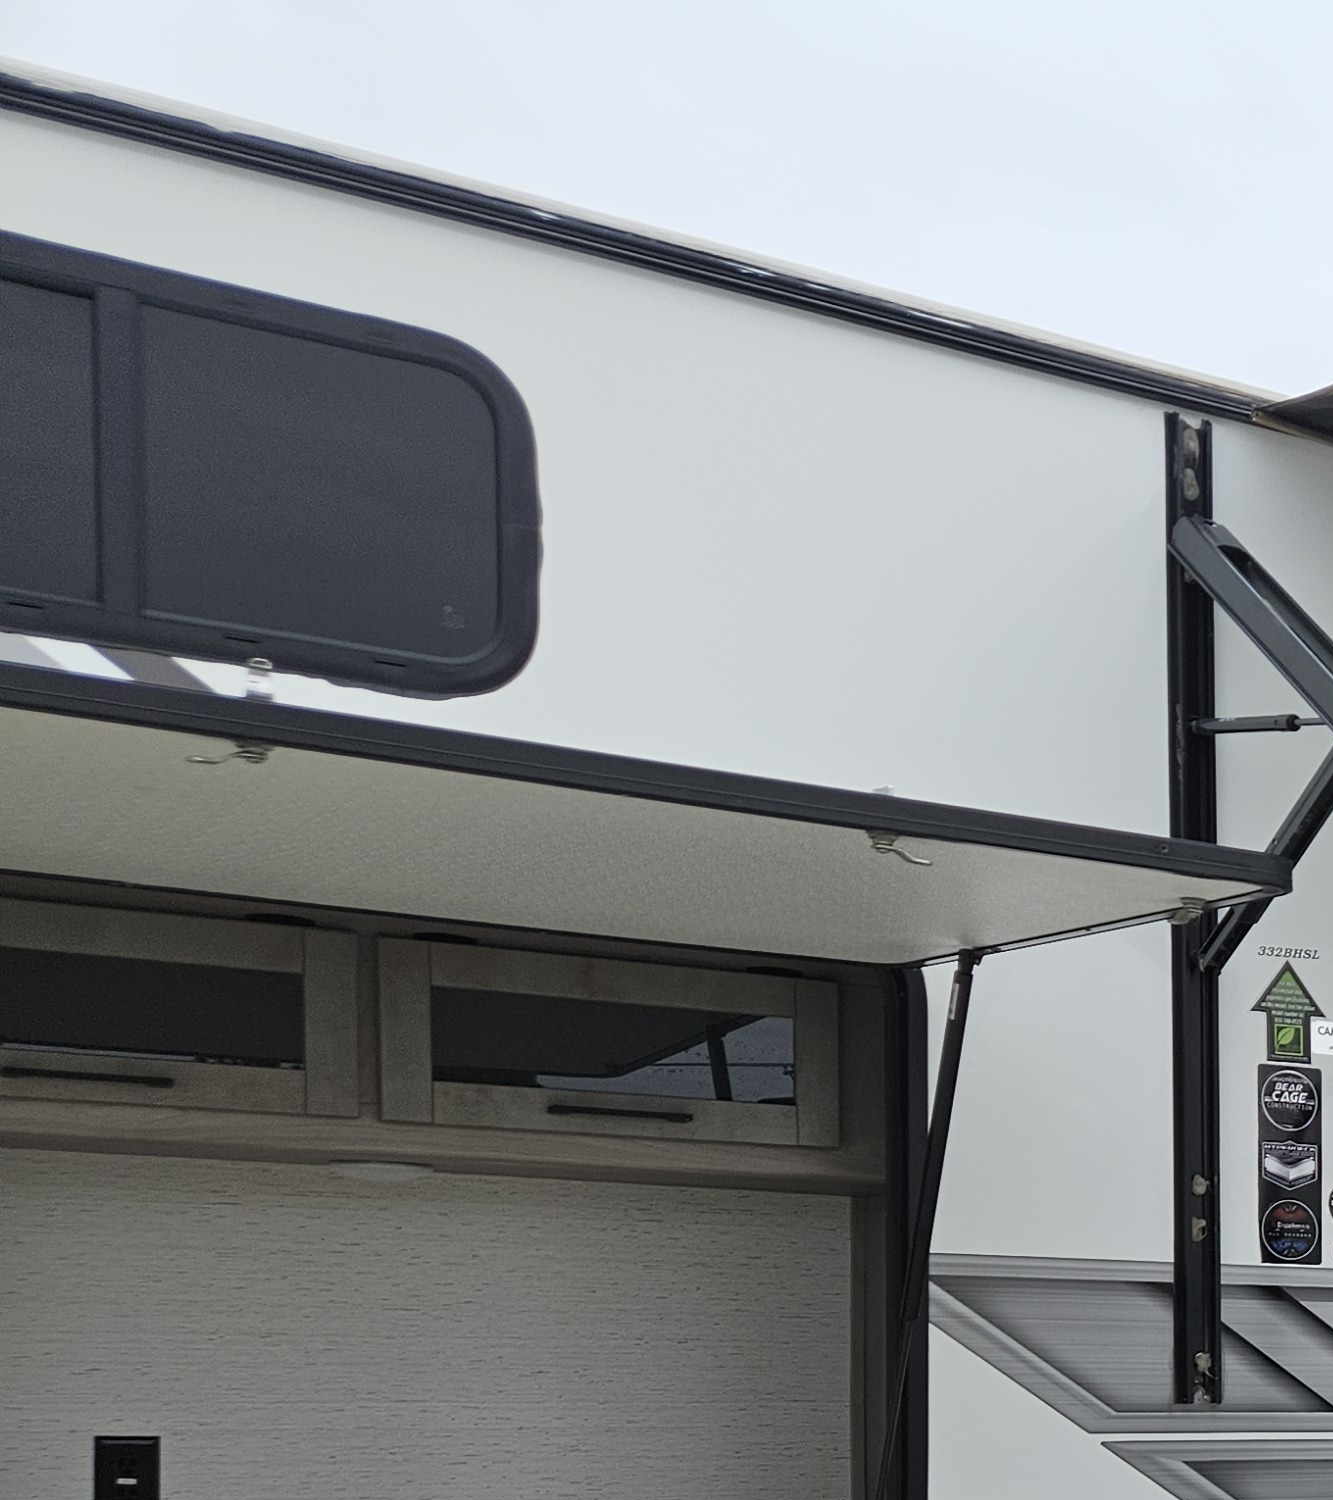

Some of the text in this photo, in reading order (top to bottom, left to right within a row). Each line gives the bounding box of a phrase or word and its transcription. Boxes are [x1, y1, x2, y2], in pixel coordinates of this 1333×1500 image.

[1258, 946, 1320, 959] 332BHSL
[1275, 1082, 1303, 1091] BEAR
[1272, 1091, 1308, 1103] CAGE
[1266, 1102, 1313, 1110] CONSTRUCTION
